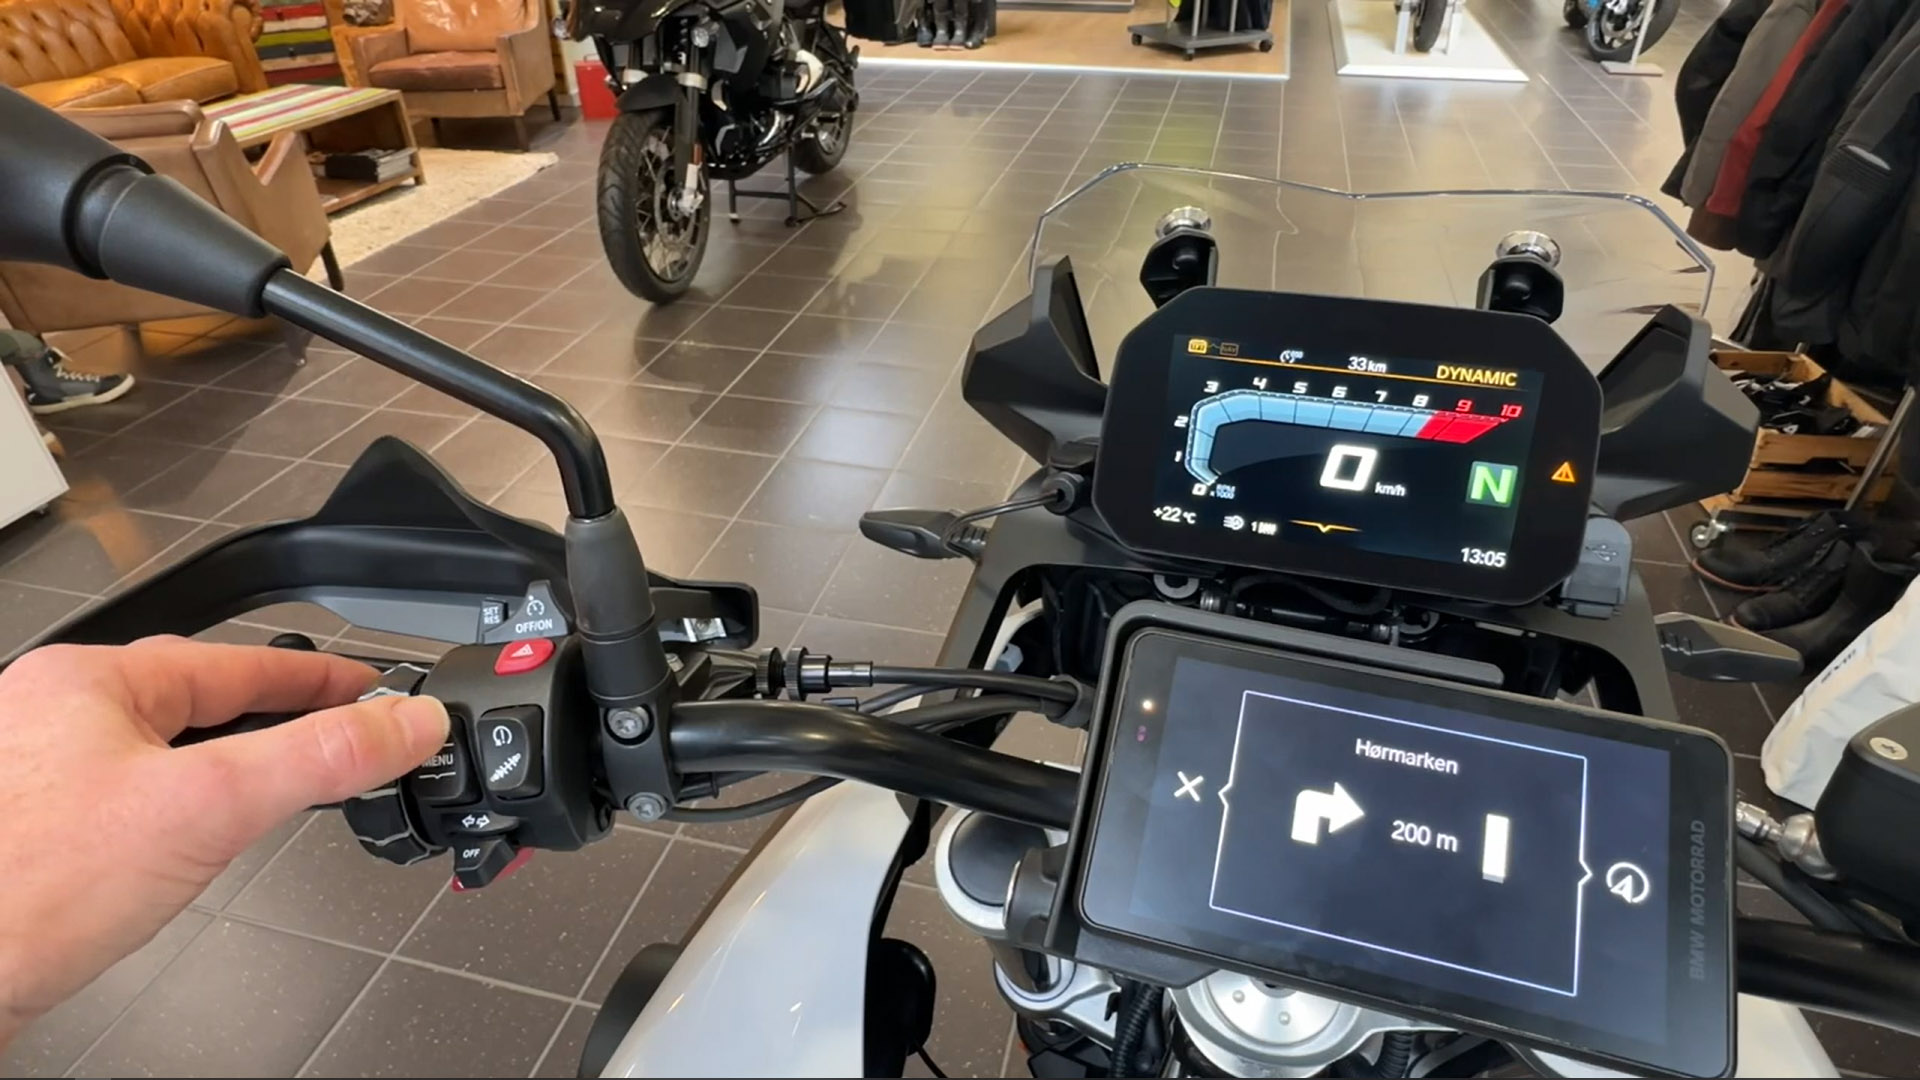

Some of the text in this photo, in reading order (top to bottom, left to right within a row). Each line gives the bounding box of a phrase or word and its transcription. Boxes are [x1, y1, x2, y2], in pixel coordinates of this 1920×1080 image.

[1347, 356, 1387, 373] 33 km
[1435, 364, 1518, 387] DYNAMIC
[1203, 380, 1219, 393] 3
[1252, 377, 1267, 389] 4
[1292, 382, 1308, 394] 5
[1331, 386, 1347, 398] 6
[1374, 390, 1387, 403] 7
[1412, 394, 1429, 408] 8
[1455, 400, 1473, 413] 9
[1500, 404, 1522, 418] 10
[1173, 415, 1189, 428] 2
[1174, 450, 1182, 463] 1
[1319, 444, 1406, 497] 0 km/h
[1470, 465, 1513, 504] N
[1153, 506, 1182, 522] +22
[1461, 548, 1507, 568] 13:05
[483, 606, 499, 615] SET
[515, 619, 553, 633] OFF/ON
[1355, 738, 1459, 775] Hørmarken
[1391, 820, 1458, 852] 200 m
[462, 848, 481, 859] OFF
[1690, 820, 1705, 980] BMW MOTORRAD
